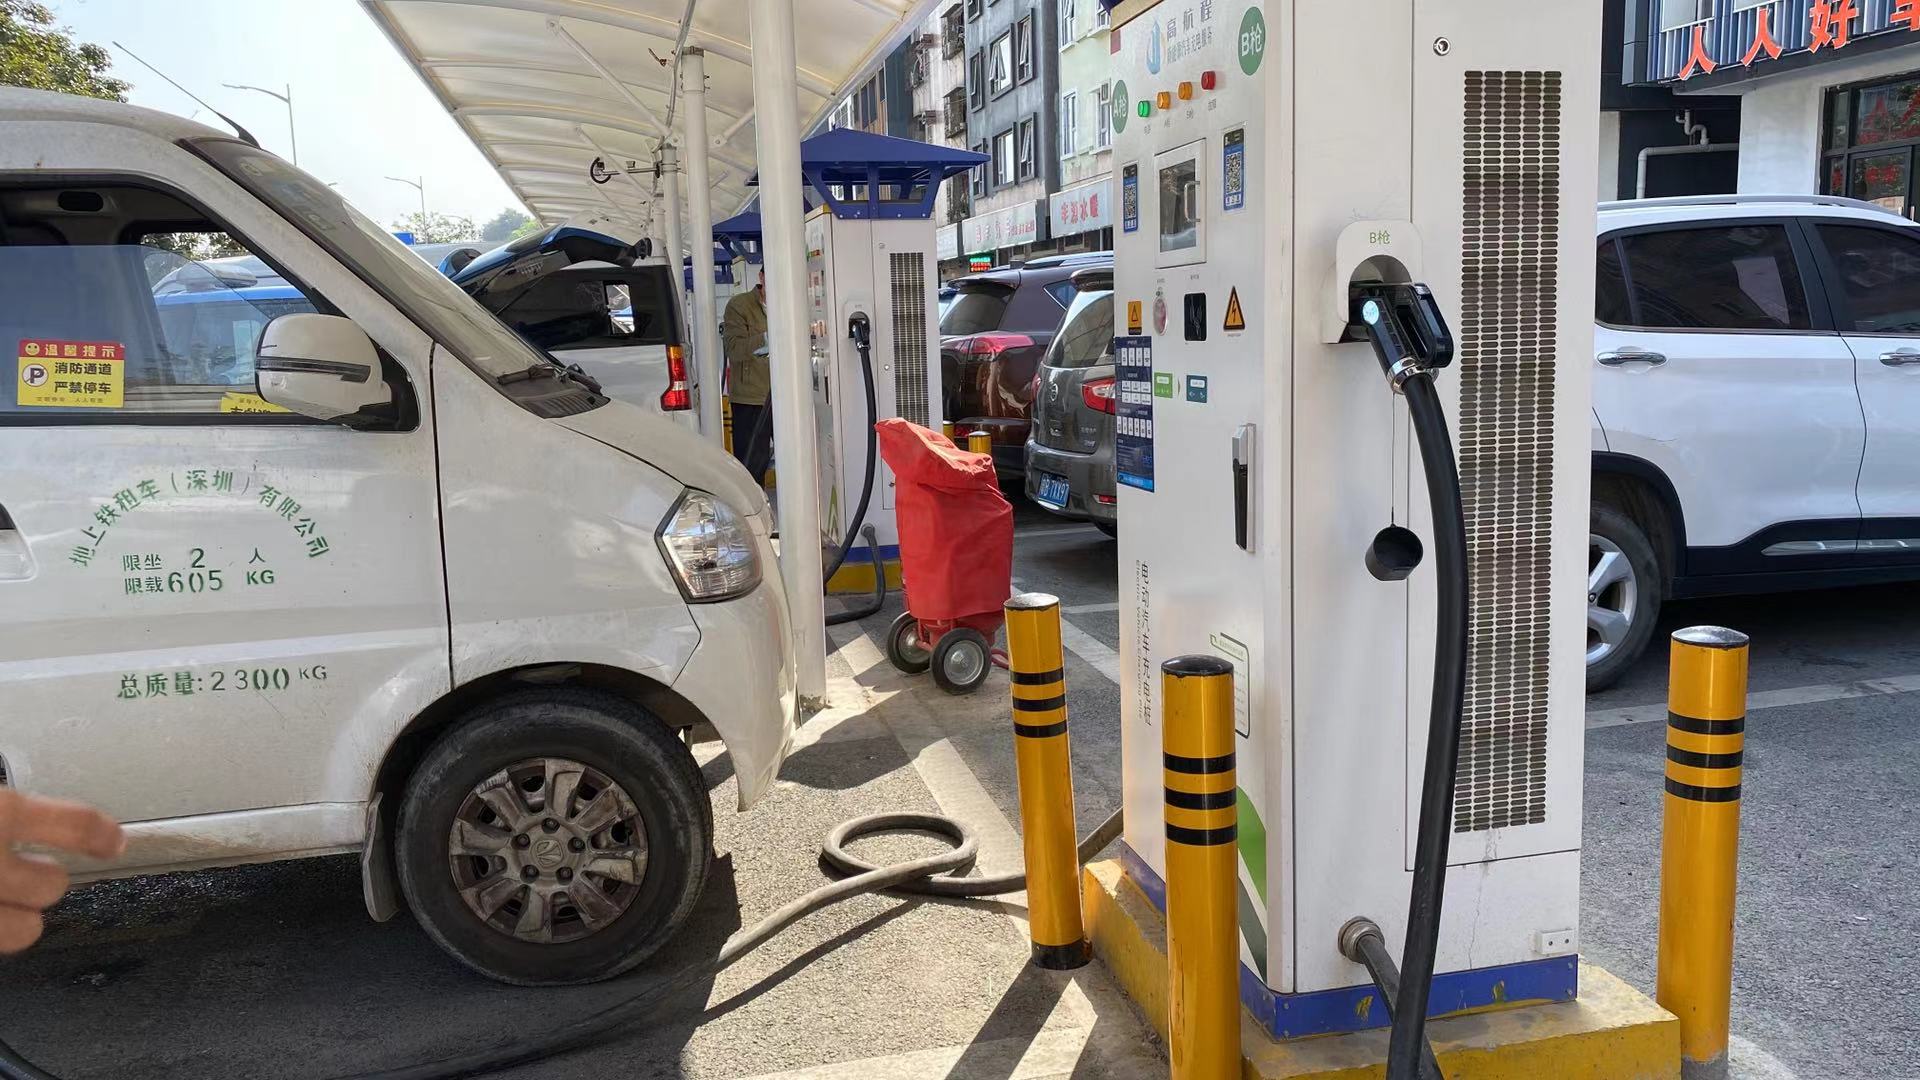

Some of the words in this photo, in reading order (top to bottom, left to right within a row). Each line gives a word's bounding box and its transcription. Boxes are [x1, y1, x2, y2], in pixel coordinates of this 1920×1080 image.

[1167, 0, 1212, 42] 高航程
[1241, 22, 1263, 57] B枪
[1112, 95, 1127, 119] A枪
[1369, 230, 1391, 245] B枪
[54, 362, 112, 376] 消防通道
[54, 381, 112, 395] 严禁停车
[122, 553, 162, 572] 限坐
[190, 547, 206, 569] 2
[248, 547, 265, 564] 人
[246, 569, 275, 586] KG
[299, 664, 328, 681] KG
